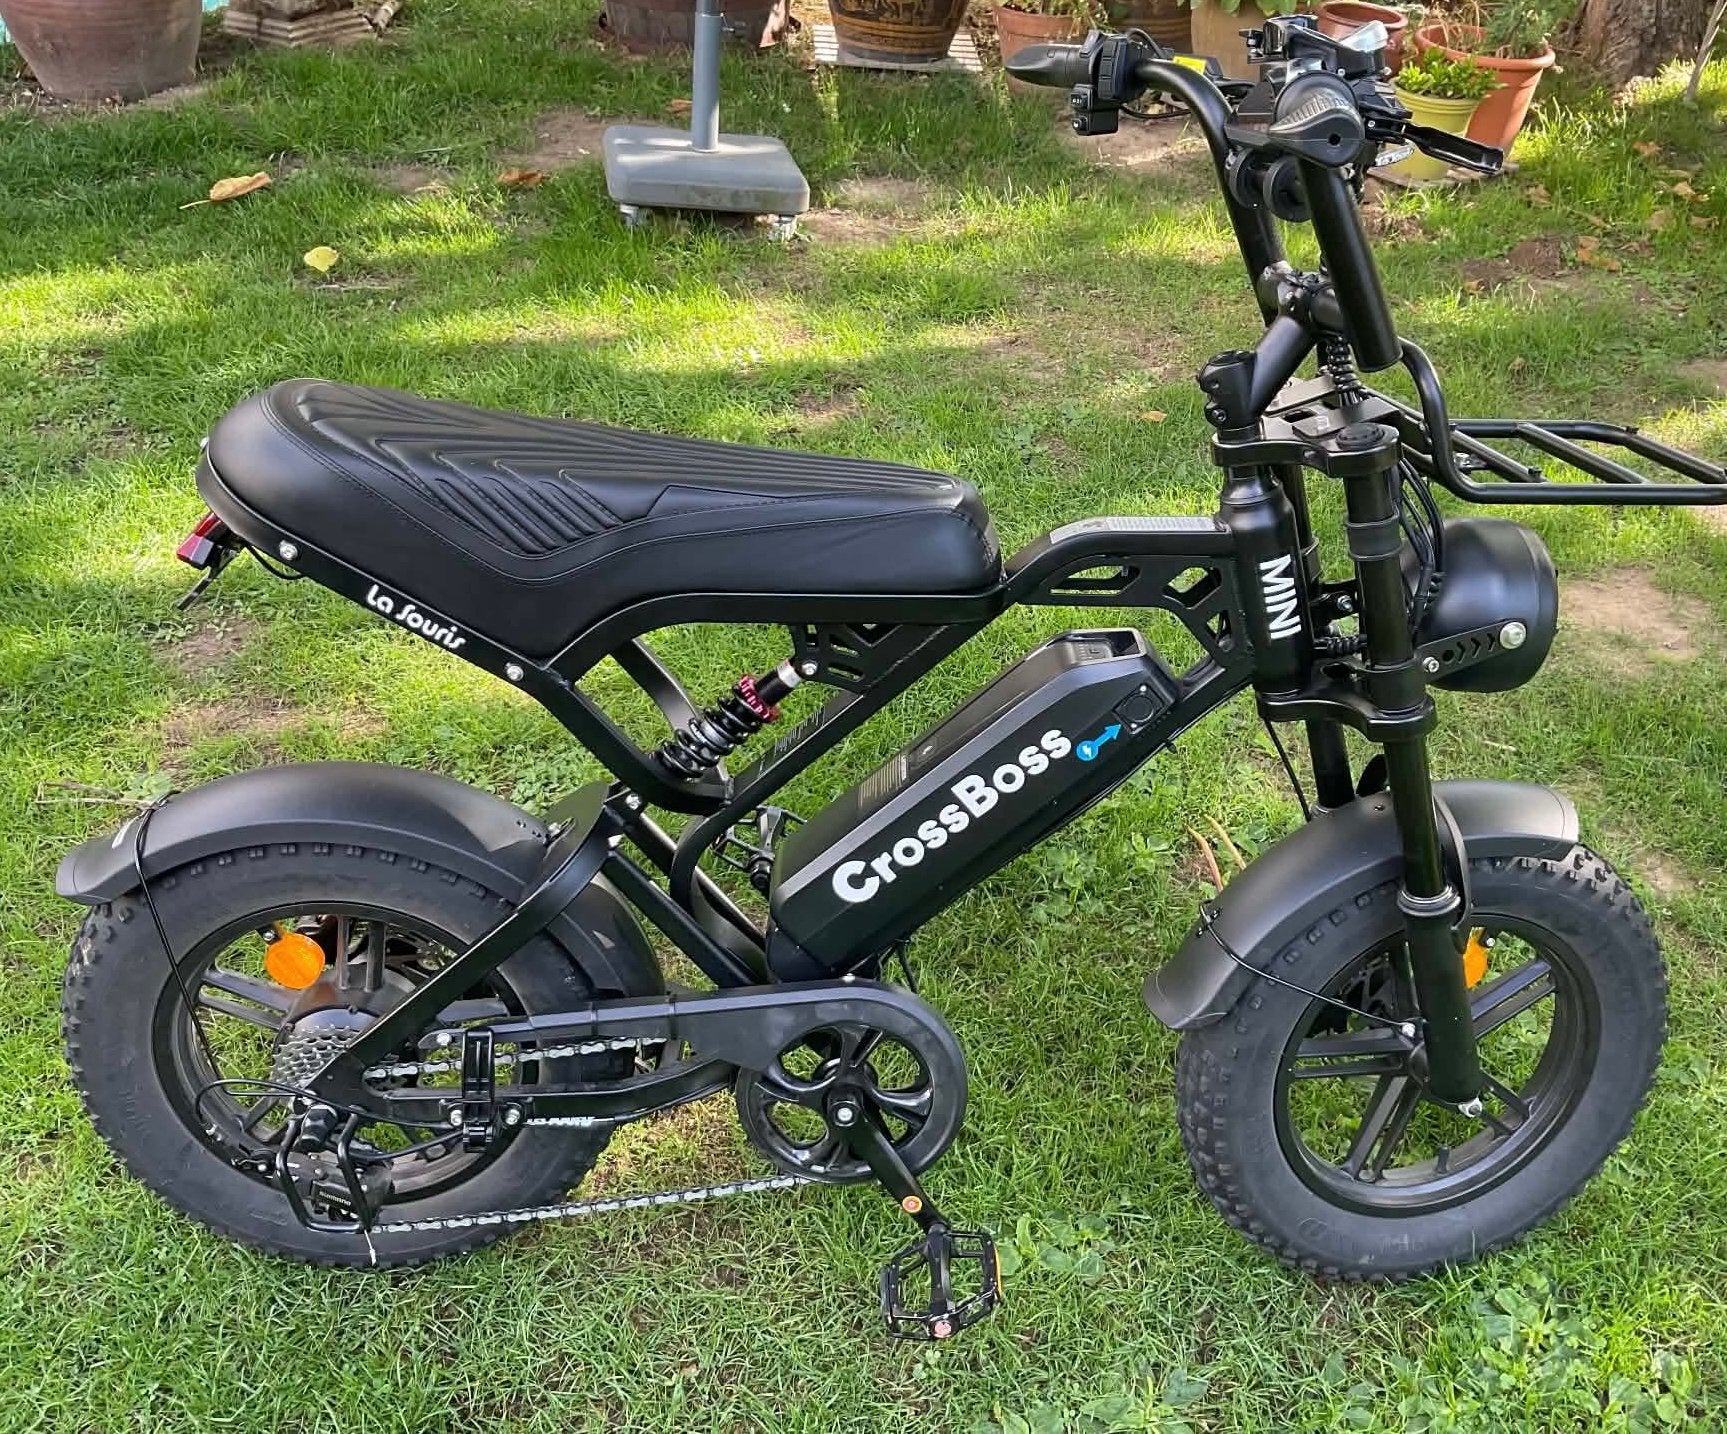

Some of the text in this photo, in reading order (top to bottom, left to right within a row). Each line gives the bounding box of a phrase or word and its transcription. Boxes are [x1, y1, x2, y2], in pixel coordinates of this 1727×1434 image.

[366, 583, 467, 649] La Souris
[1259, 553, 1302, 639] MINI
[832, 729, 1072, 903] CrossBoss
